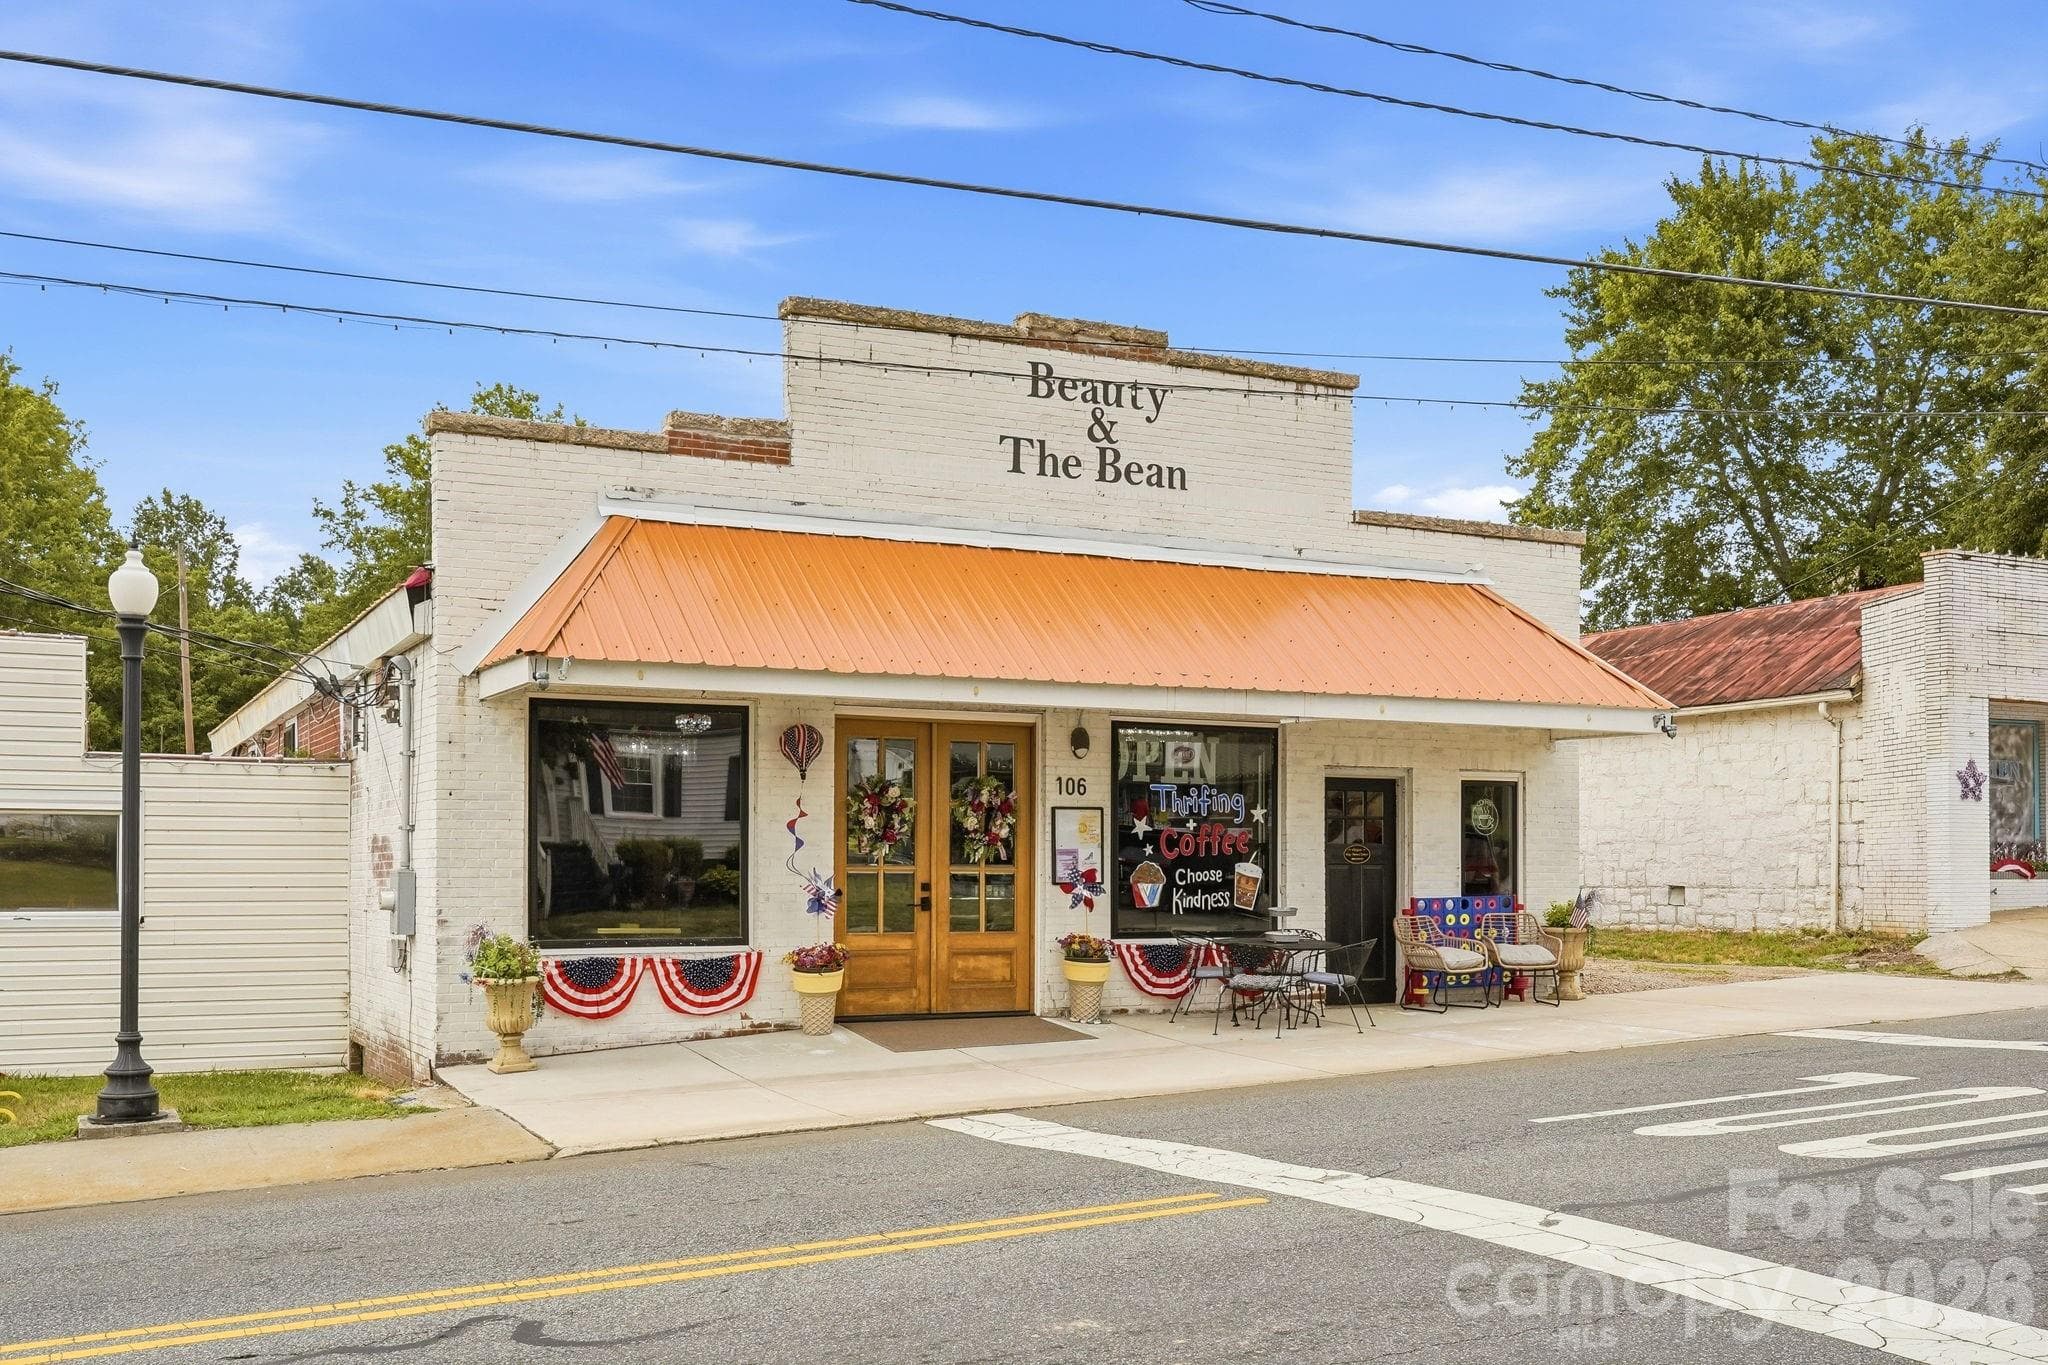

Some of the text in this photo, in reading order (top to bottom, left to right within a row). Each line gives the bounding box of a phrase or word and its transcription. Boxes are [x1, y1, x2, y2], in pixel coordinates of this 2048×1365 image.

[1027, 361, 1169, 423] Beauty
[1087, 406, 1119, 444] &
[998, 434, 1188, 490] The Bean
[1056, 776, 1087, 796] 106
[1159, 823, 1251, 860] Coffee
[1175, 868, 1223, 885] Choose
[1172, 887, 1231, 915] Kindness
